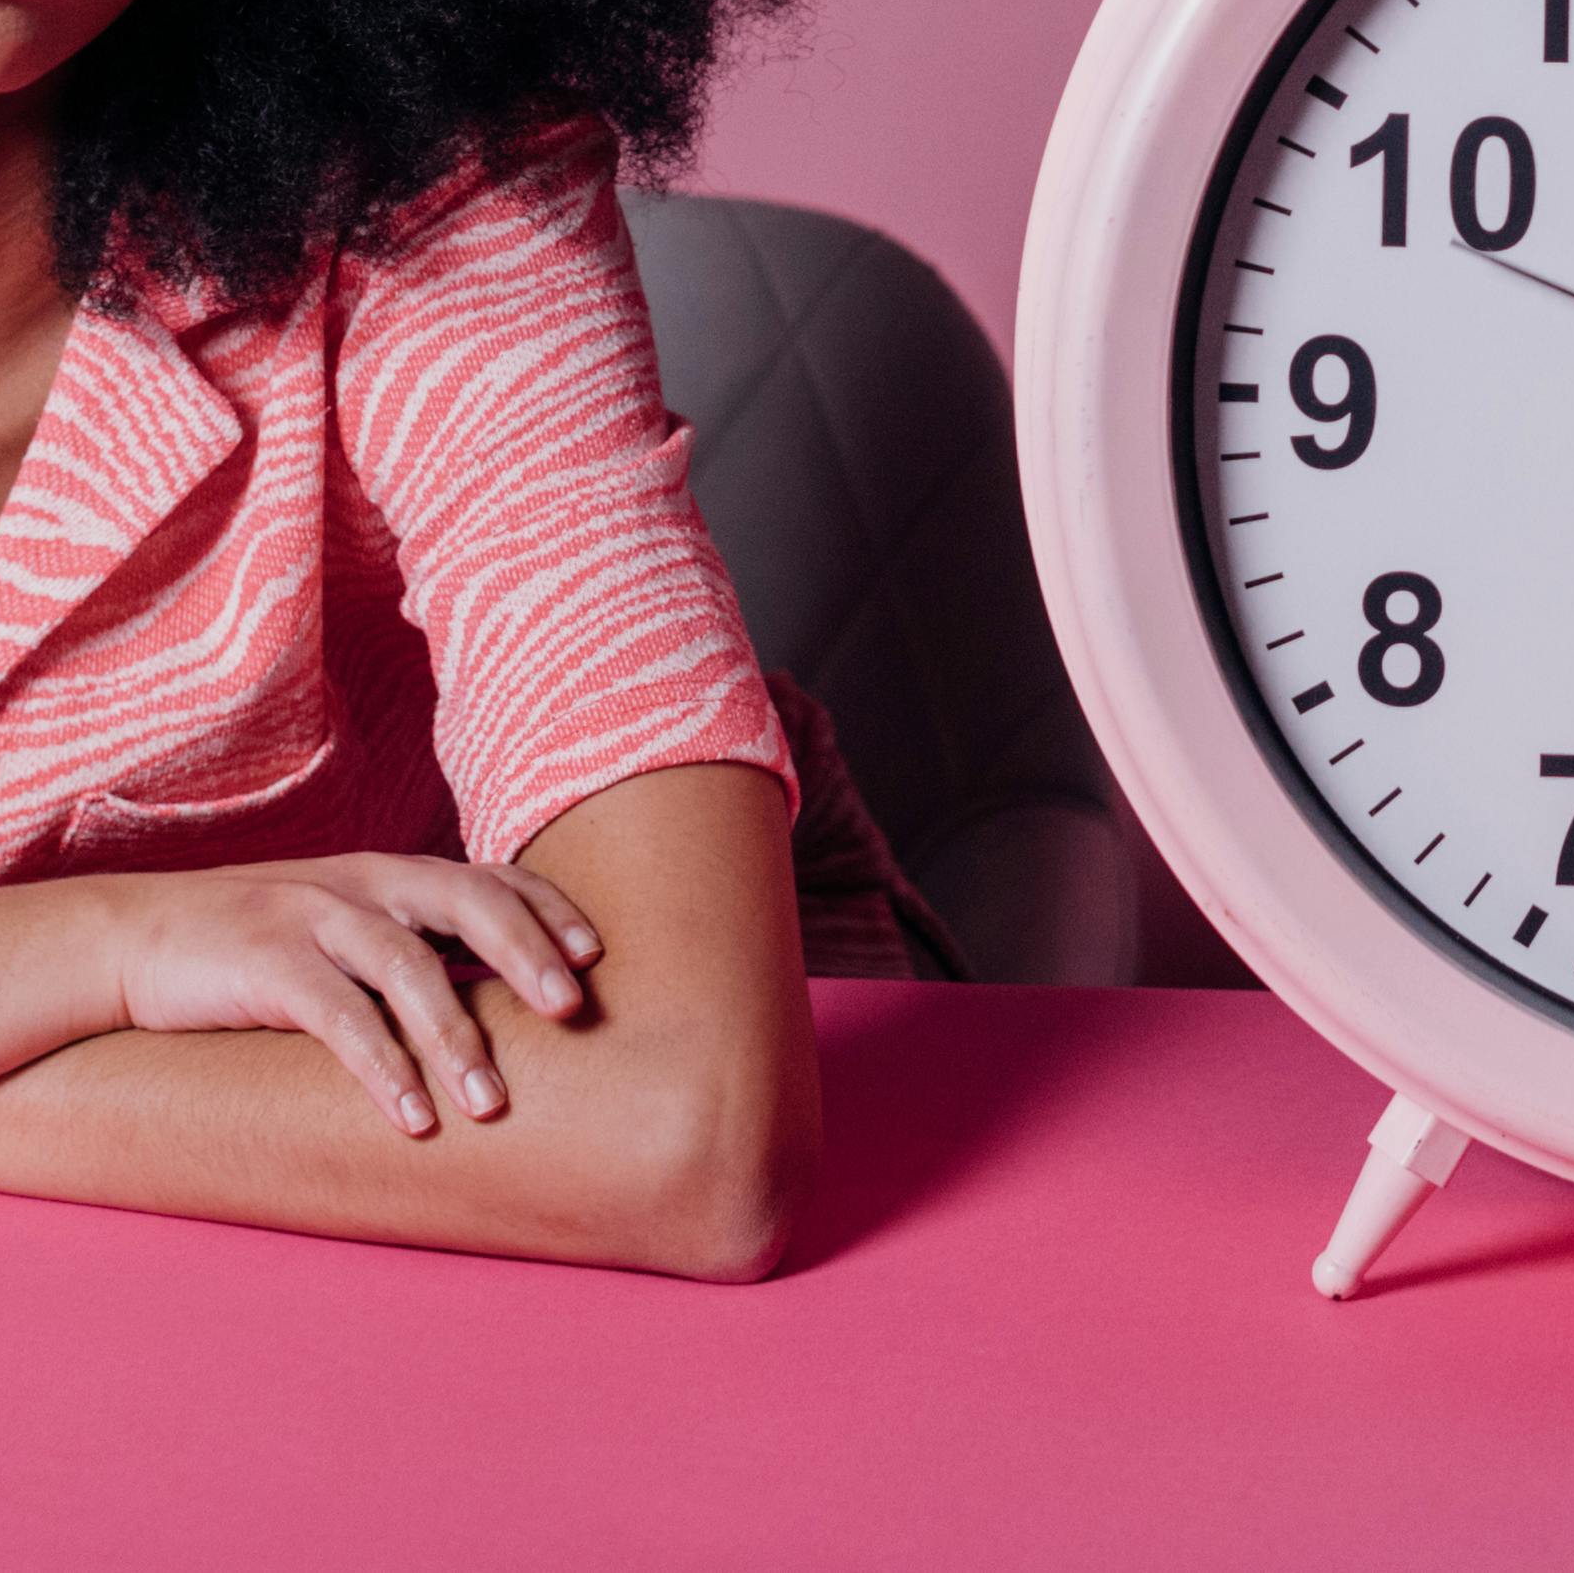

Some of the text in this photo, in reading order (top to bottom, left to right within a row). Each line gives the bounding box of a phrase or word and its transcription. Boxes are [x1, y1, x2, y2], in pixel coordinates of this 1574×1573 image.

[1349, 113, 1537, 252] 10
[1288, 334, 1378, 471] 9
[1357, 571, 1446, 708] 8
